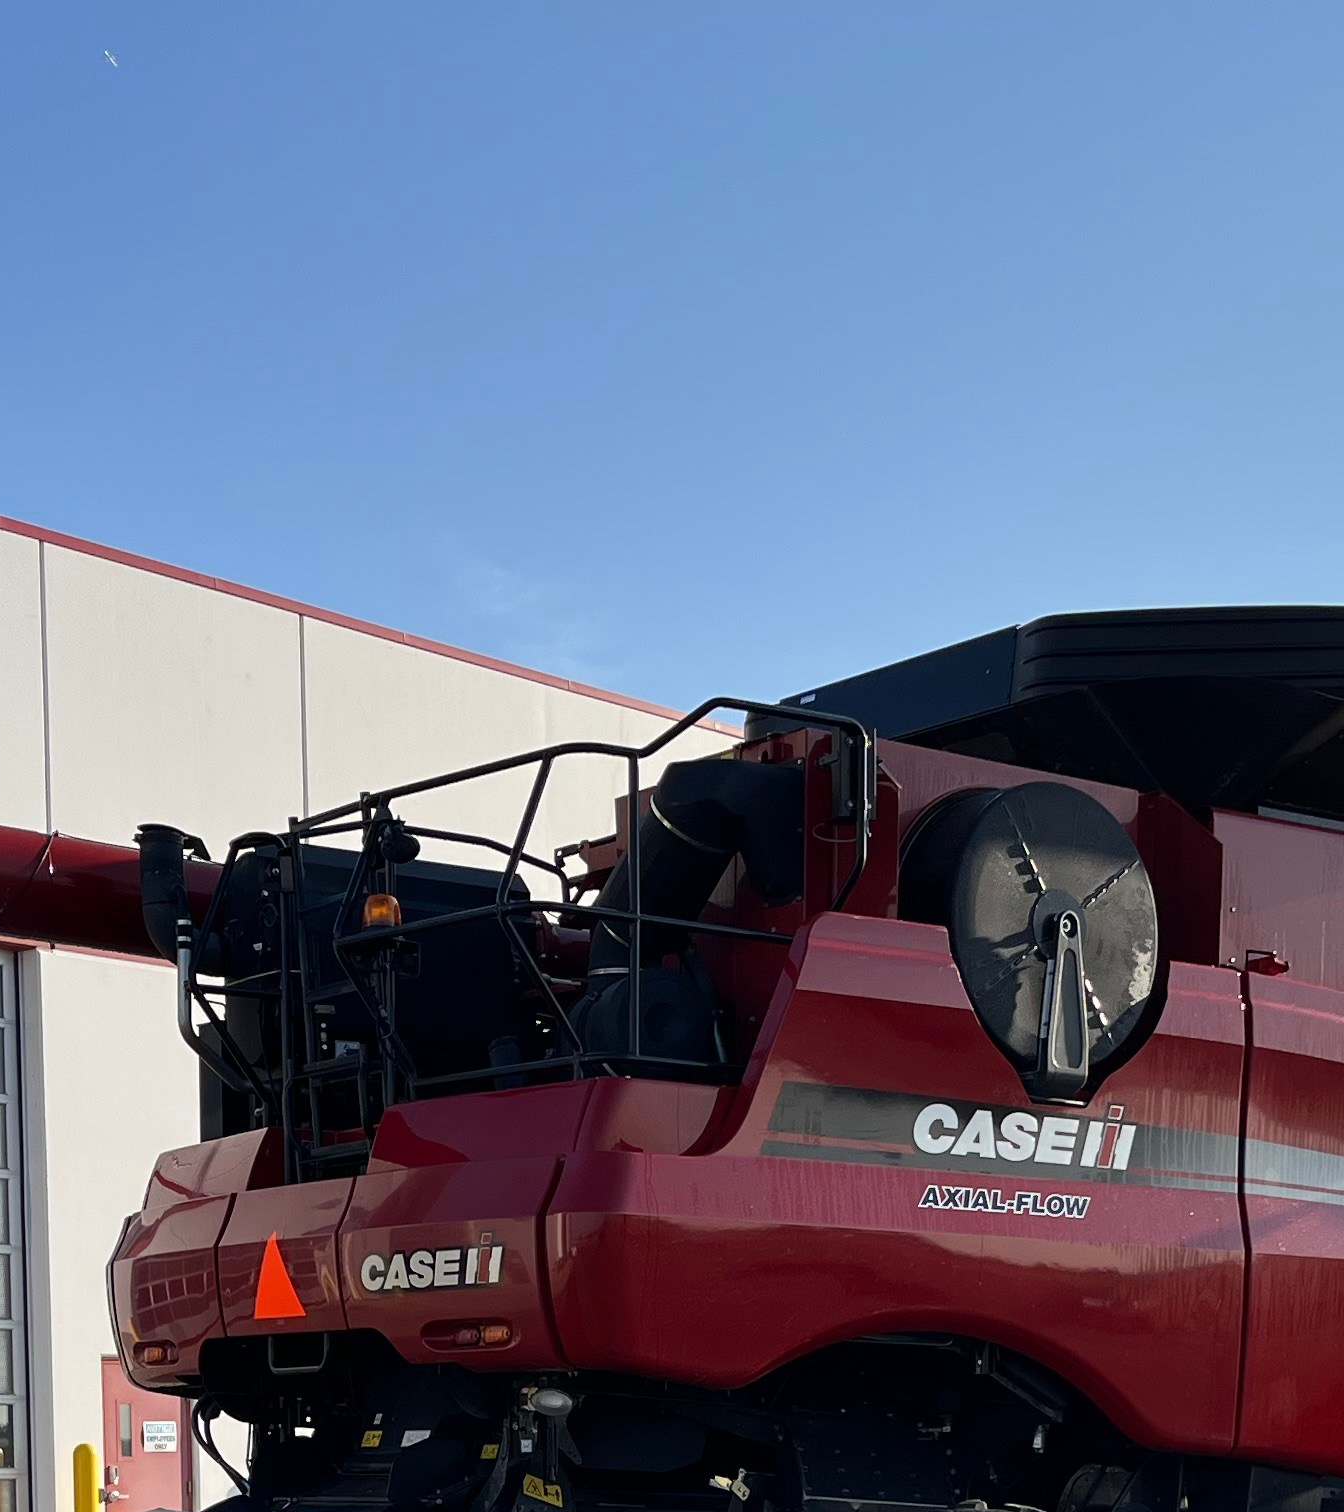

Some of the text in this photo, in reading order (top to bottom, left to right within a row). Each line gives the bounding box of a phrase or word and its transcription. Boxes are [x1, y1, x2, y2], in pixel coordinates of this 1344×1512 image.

[912, 1102, 1080, 1166] CASE
[918, 1184, 1091, 1219] AXIAL-FLOW
[360, 1249, 461, 1292] CASE
